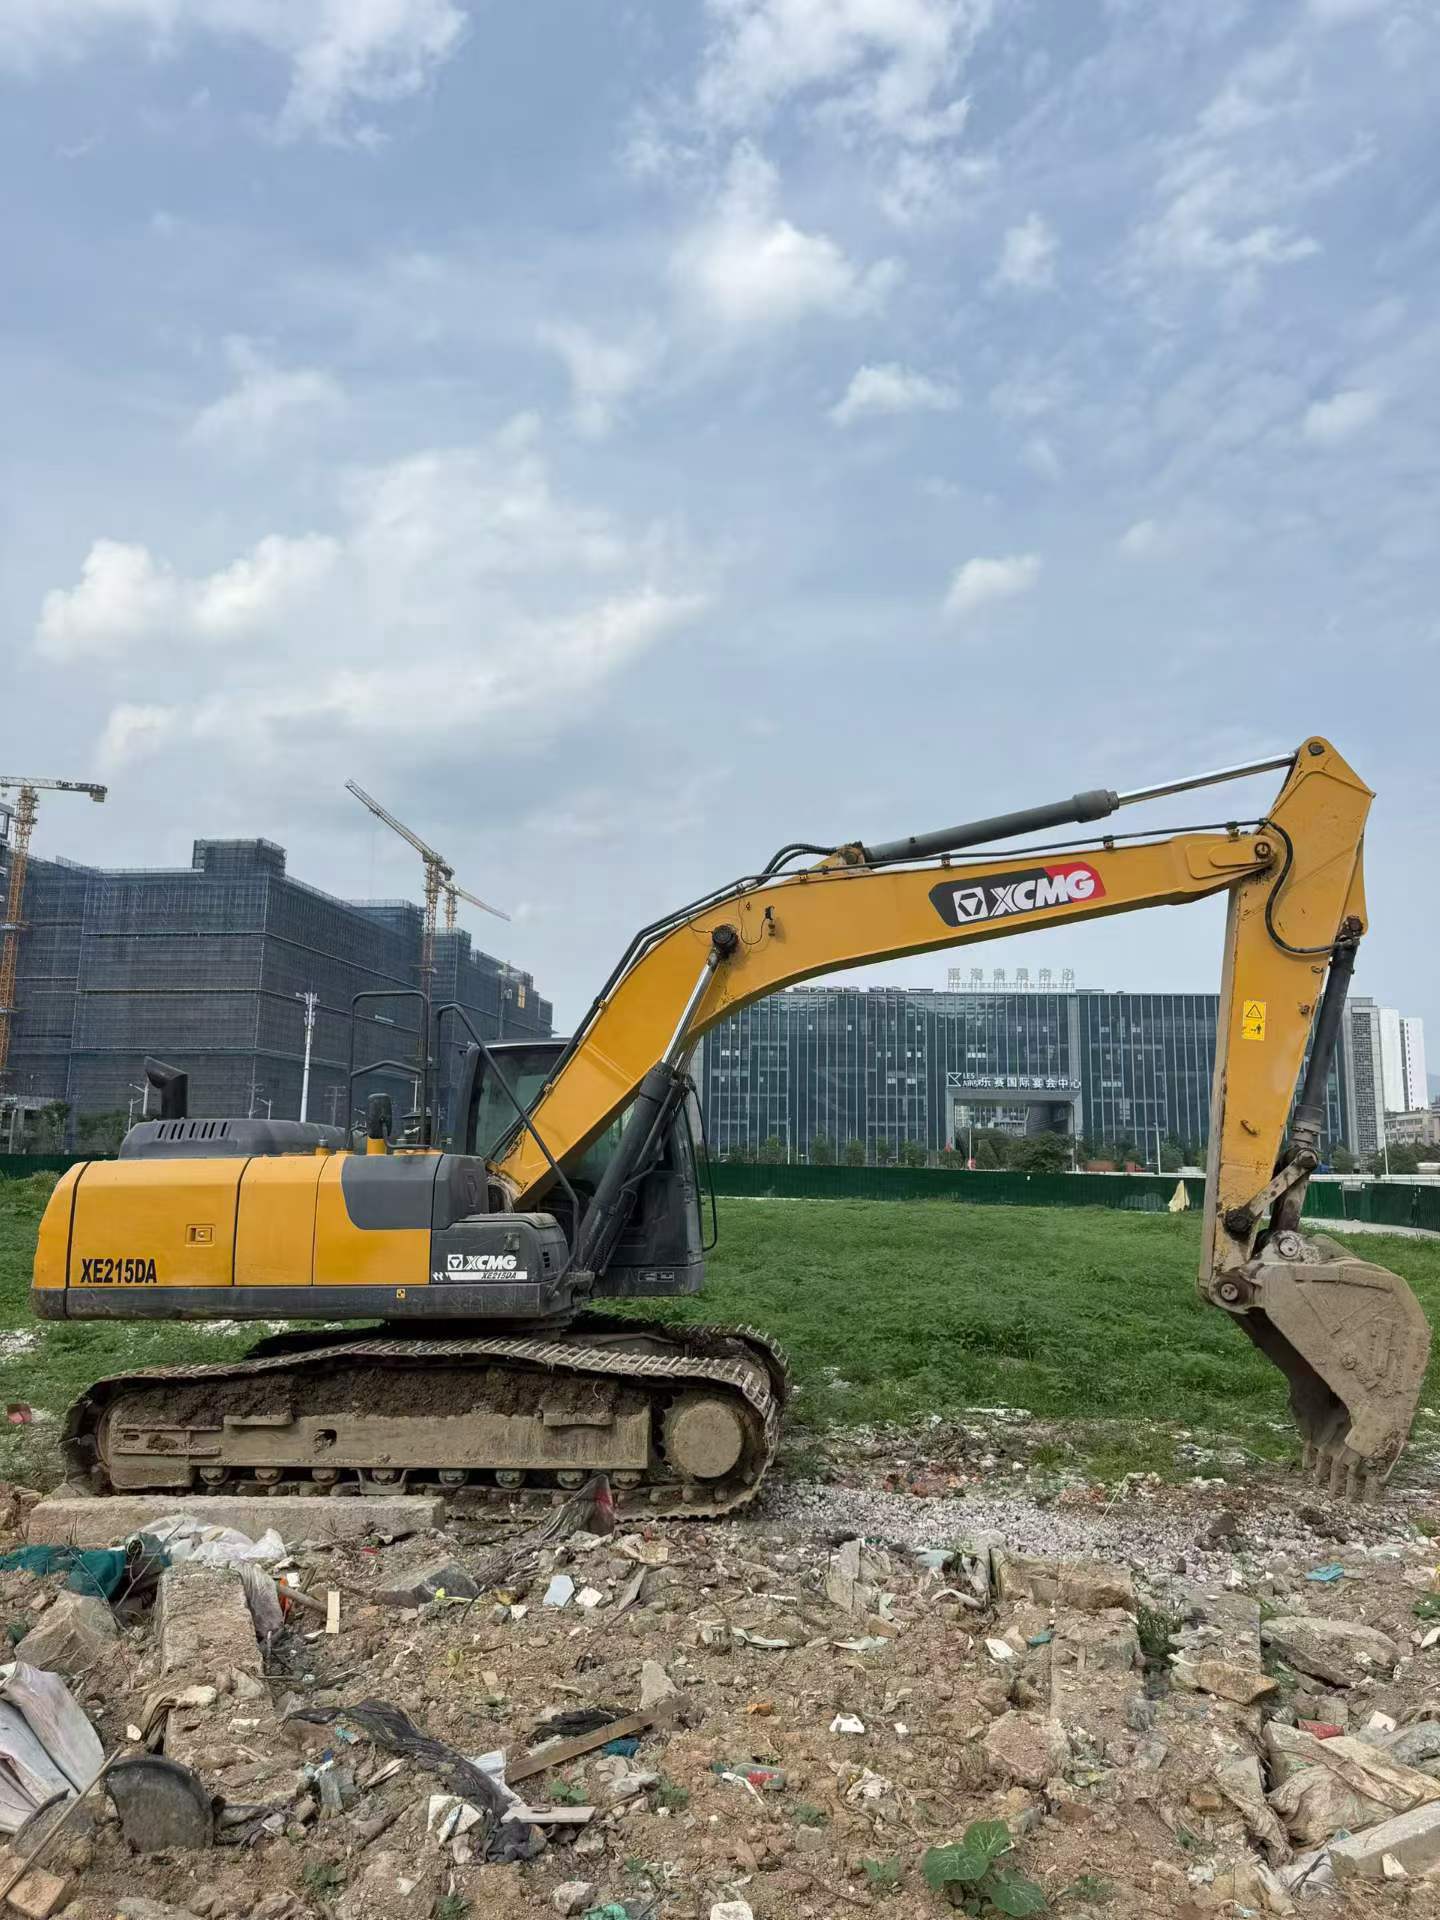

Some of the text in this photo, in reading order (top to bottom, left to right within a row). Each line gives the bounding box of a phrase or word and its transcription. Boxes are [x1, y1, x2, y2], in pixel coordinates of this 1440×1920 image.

[990, 870, 1095, 916] XCMG
[80, 1258, 157, 1283] XE215DA
[464, 1255, 517, 1270] XCMG
